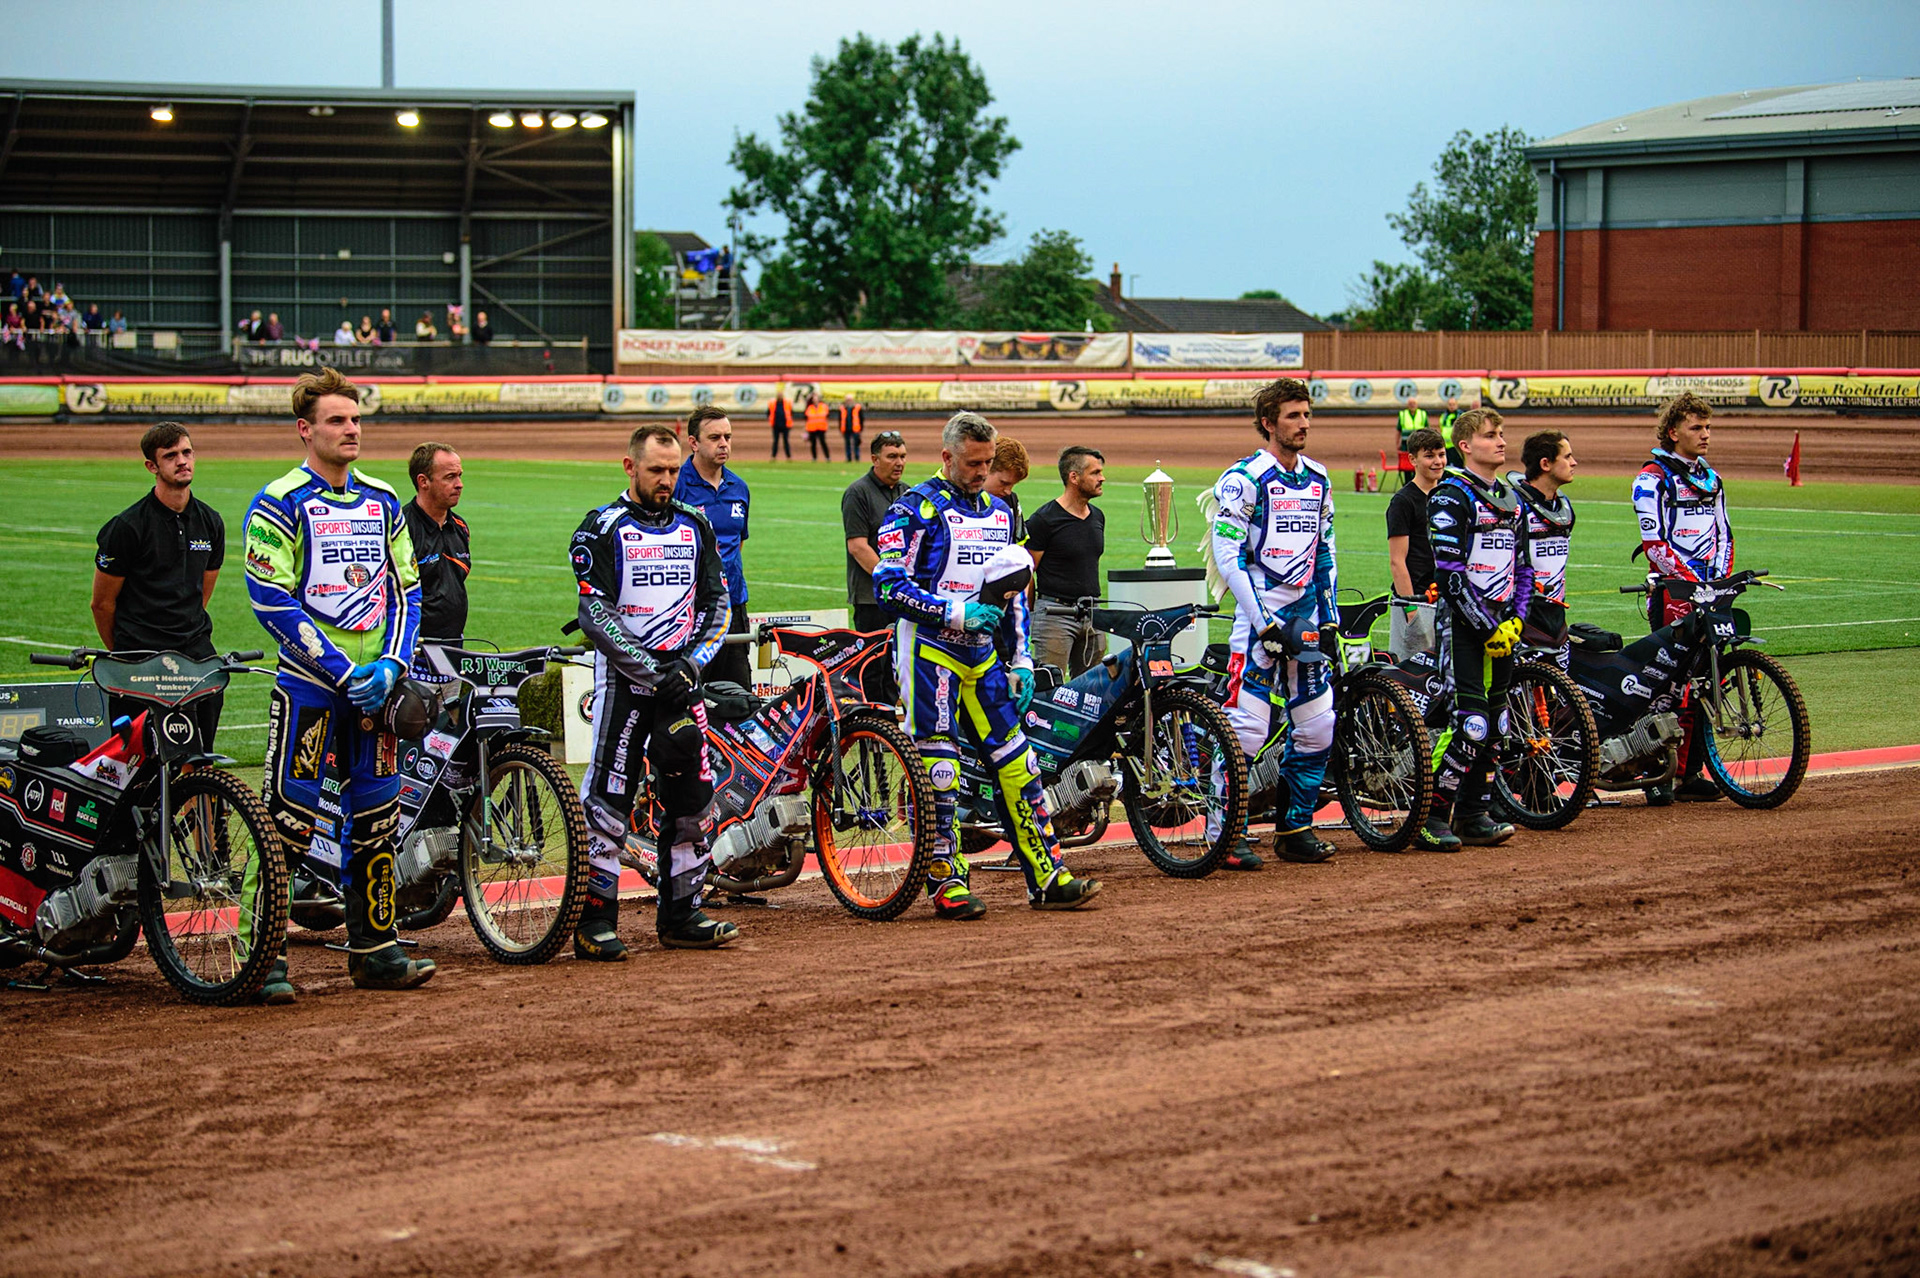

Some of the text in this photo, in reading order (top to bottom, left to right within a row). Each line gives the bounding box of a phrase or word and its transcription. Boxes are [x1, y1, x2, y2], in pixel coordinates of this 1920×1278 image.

[251, 350, 278, 365] THE
[281, 350, 314, 367] RUG
[316, 350, 373, 367] OUTLET
[1675, 377, 1704, 387] 01706
[1708, 378, 1744, 388] 640055
[1560, 384, 1637, 396] Rochdale
[1833, 384, 1909, 397] Rochdale
[1847, 397, 1882, 406] MINIBUS
[367, 504, 381, 516] 12
[1273, 501, 1301, 511] SPORTS
[995, 514, 1007, 525] 14
[316, 520, 381, 535] SPORTS INSURE
[1276, 521, 1317, 533] 2022
[681, 530, 692, 541] 13
[954, 529, 1007, 542] SPORTS INSURE
[322, 548, 381, 564] 2022
[627, 547, 693, 560] SPORTS INSURE
[632, 564, 669, 572] BRITISH
[632, 571, 690, 587] 2022
[318, 584, 347, 593] BRITISH
[626, 606, 655, 614] BRITISH
[895, 592, 943, 615] STELLAR
[589, 600, 601, 616] R
[596, 613, 609, 624] J
[603, 620, 643, 662] Warren
[461, 658, 526, 673] R J Warren
[487, 671, 508, 685] Ltd
[936, 679, 950, 732] TouchTec
[57, 717, 95, 726] TAURUS
[169, 723, 188, 734] ATPI
[934, 769, 953, 780] ATPI
[51, 792, 67, 813] red
[77, 811, 98, 825] ROCK OIL
[641, 851, 658, 864] NGK
[381, 864, 390, 919] REGINA
